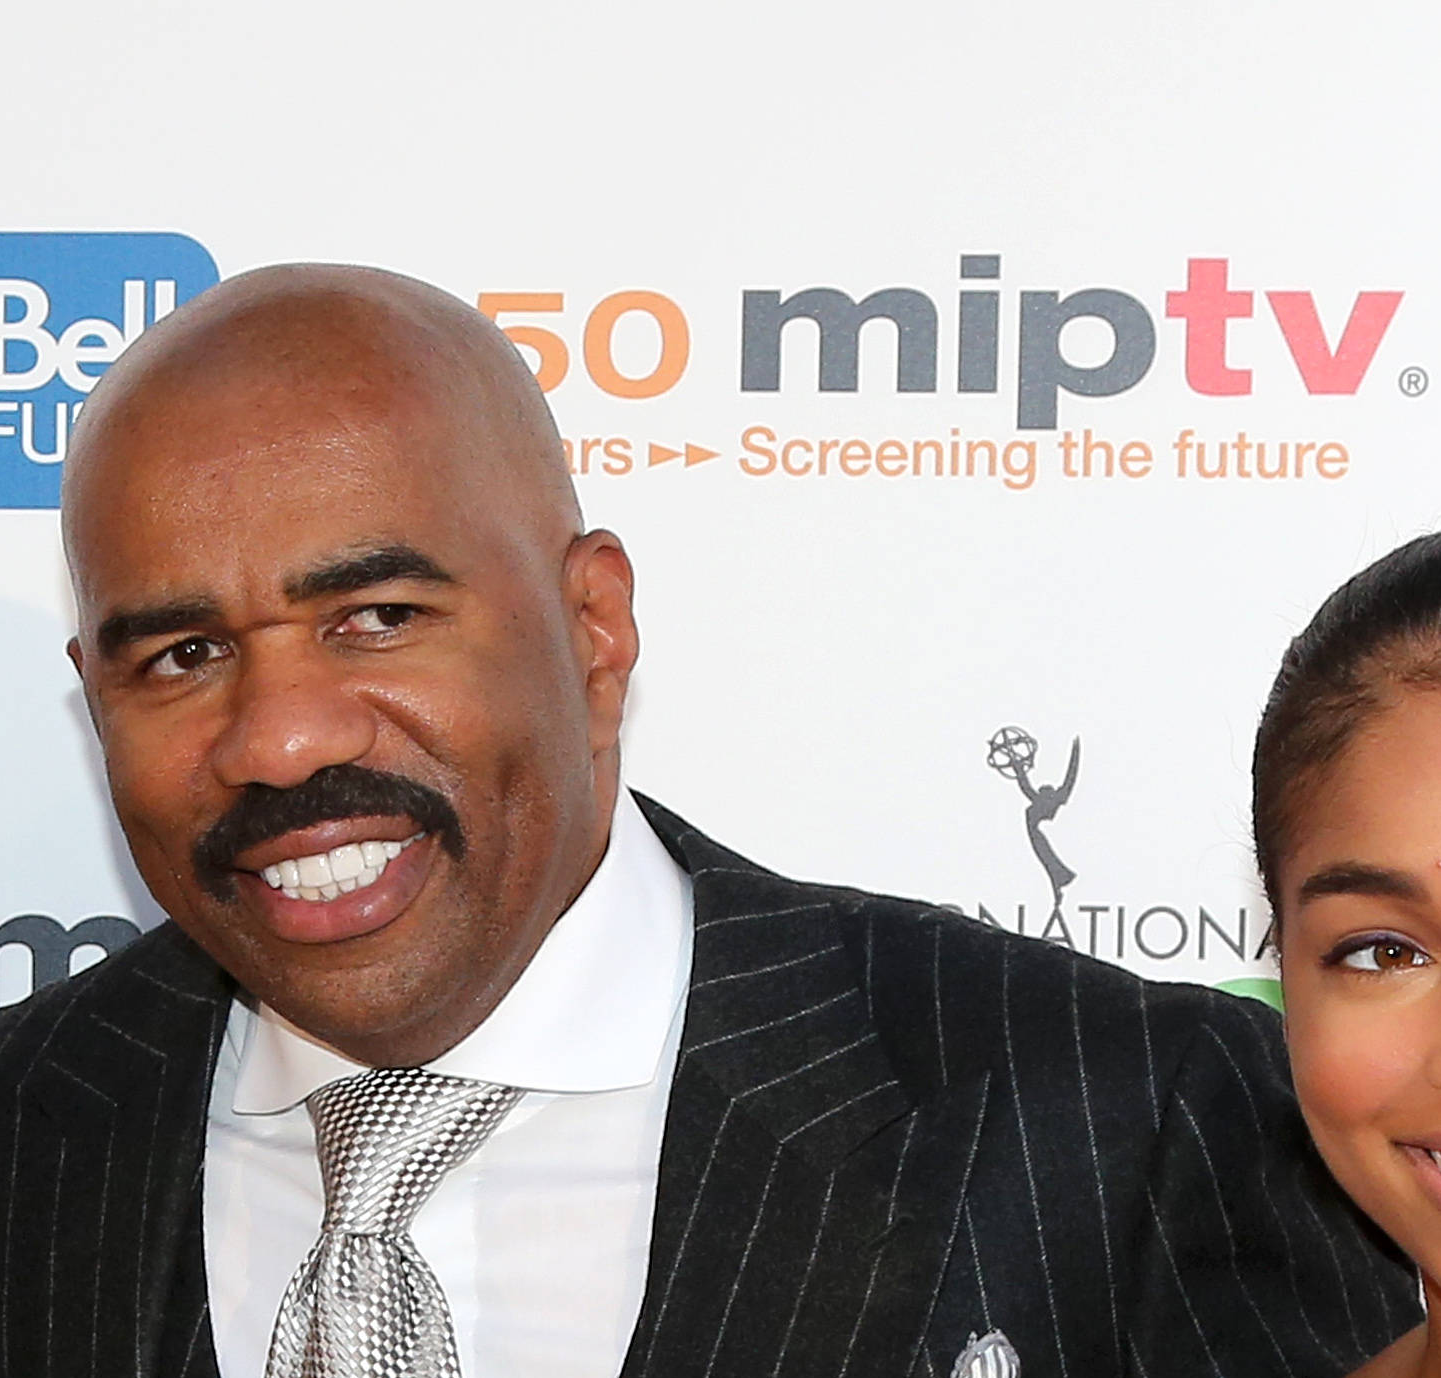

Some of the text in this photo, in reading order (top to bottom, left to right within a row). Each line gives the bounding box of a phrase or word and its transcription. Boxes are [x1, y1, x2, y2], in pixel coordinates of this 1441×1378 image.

[477, 290, 690, 399] 50
[739, 426, 1349, 490] Screening the future
